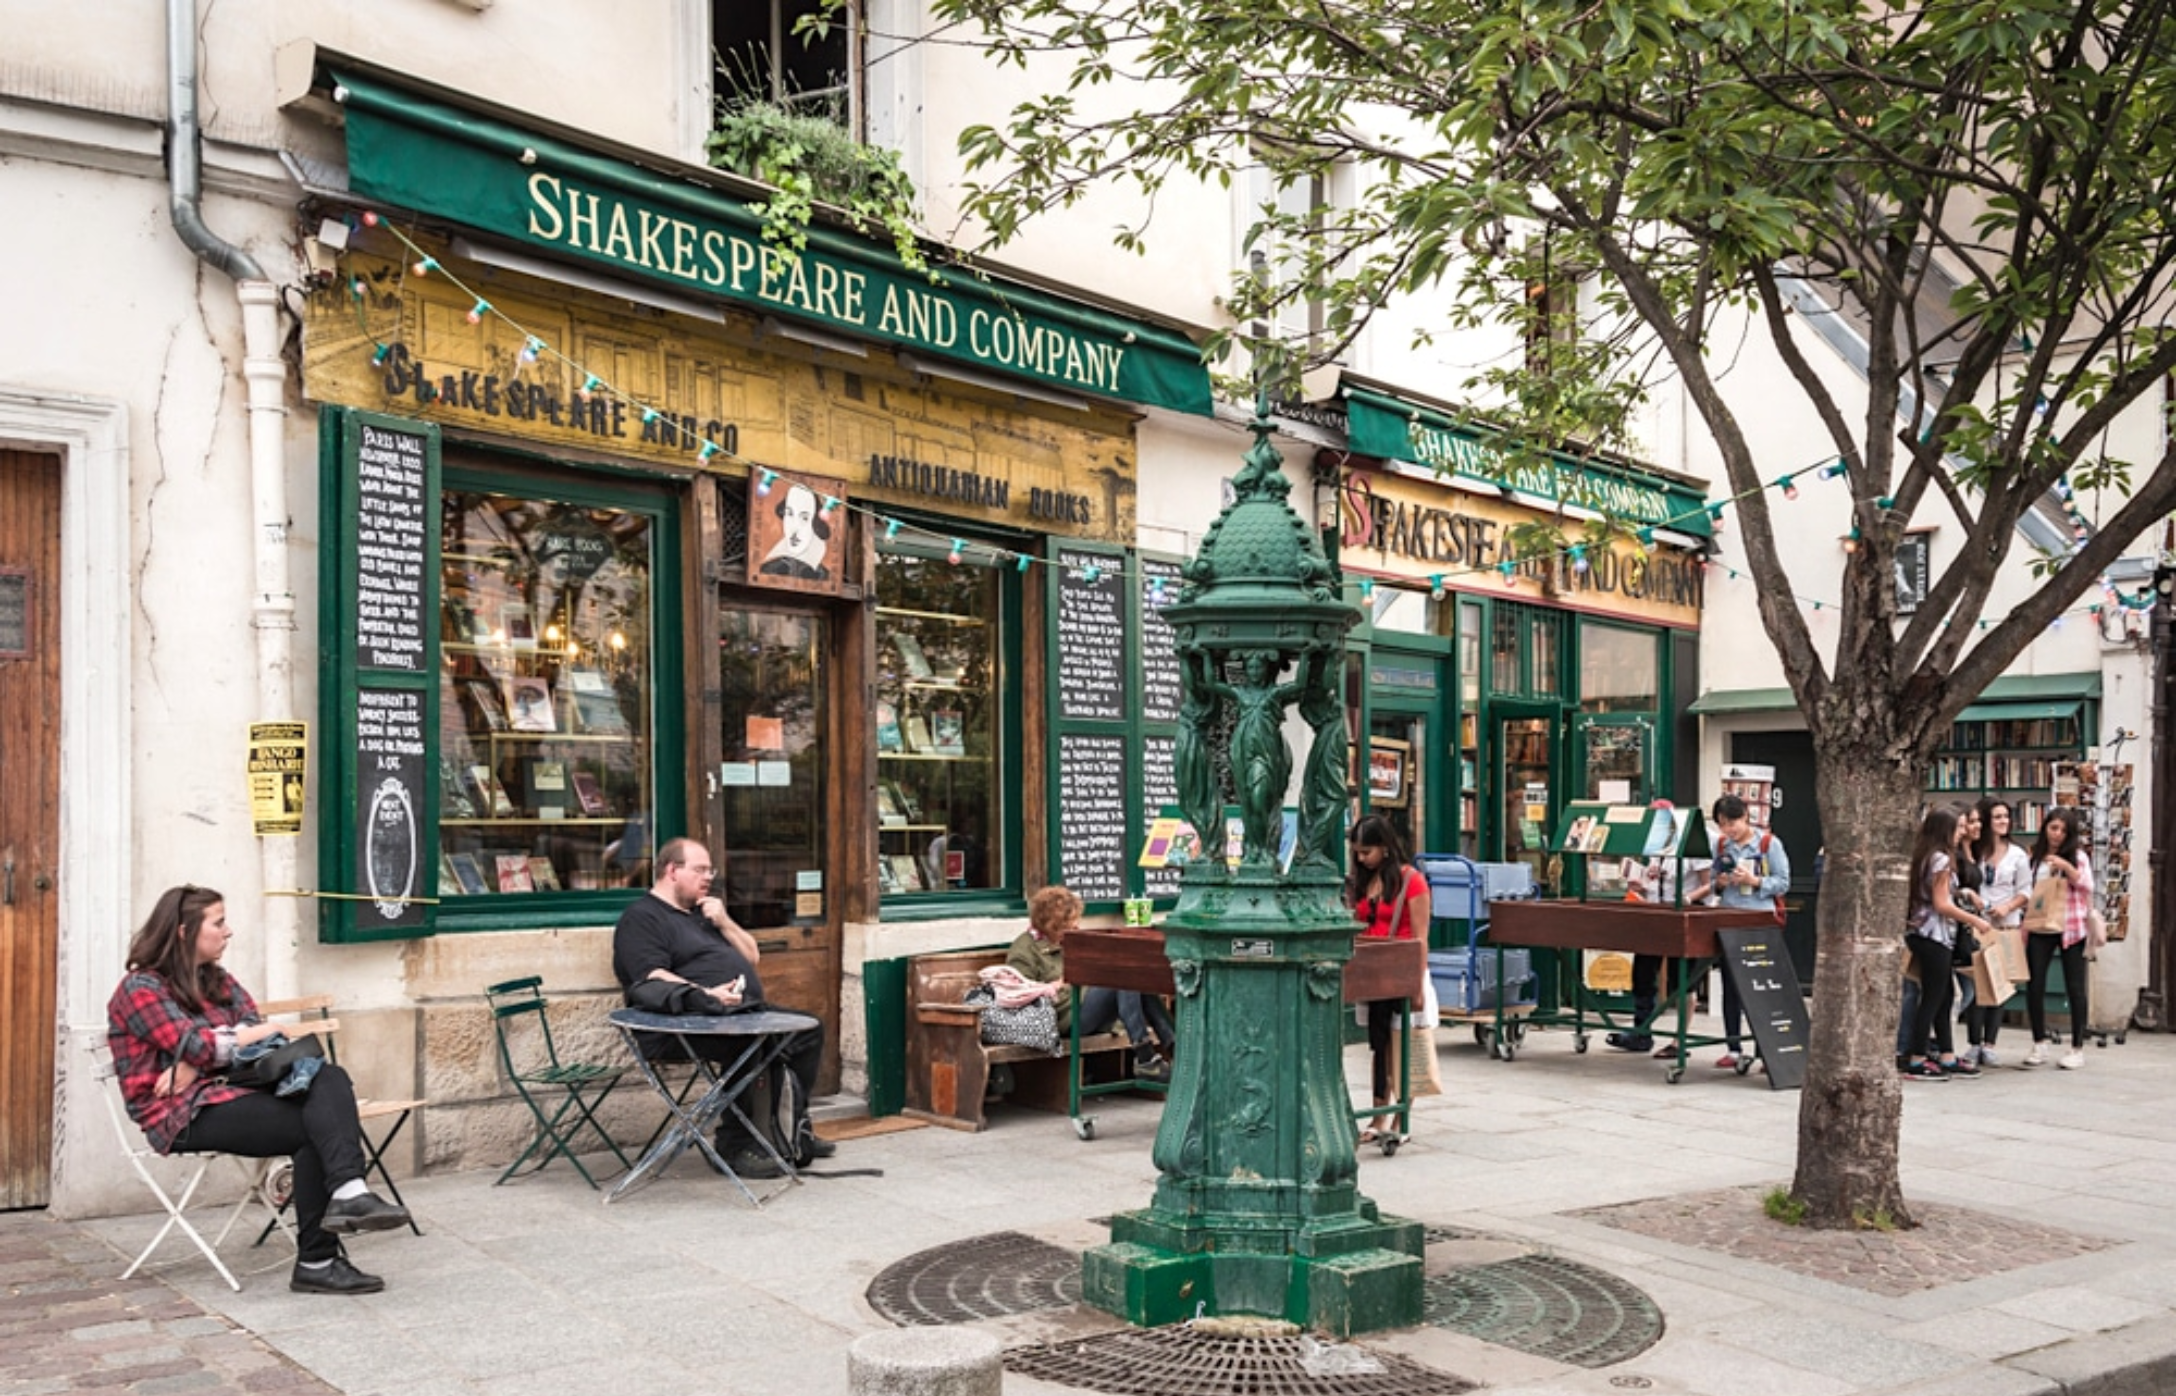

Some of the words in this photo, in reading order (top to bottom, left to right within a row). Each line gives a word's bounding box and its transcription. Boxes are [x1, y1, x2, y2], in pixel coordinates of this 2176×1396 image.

[527, 172, 867, 326] SHAKESPEARE
[878, 283, 958, 349] AND
[970, 308, 1124, 392] COMPANY
[396, 435, 421, 453] WALL
[641, 410, 697, 451] AND
[705, 419, 740, 456] CO
[870, 454, 1009, 510] ANTIQUARIAN
[1030, 487, 1090, 524] BOOKS
[1772, 787, 1784, 809] 9
